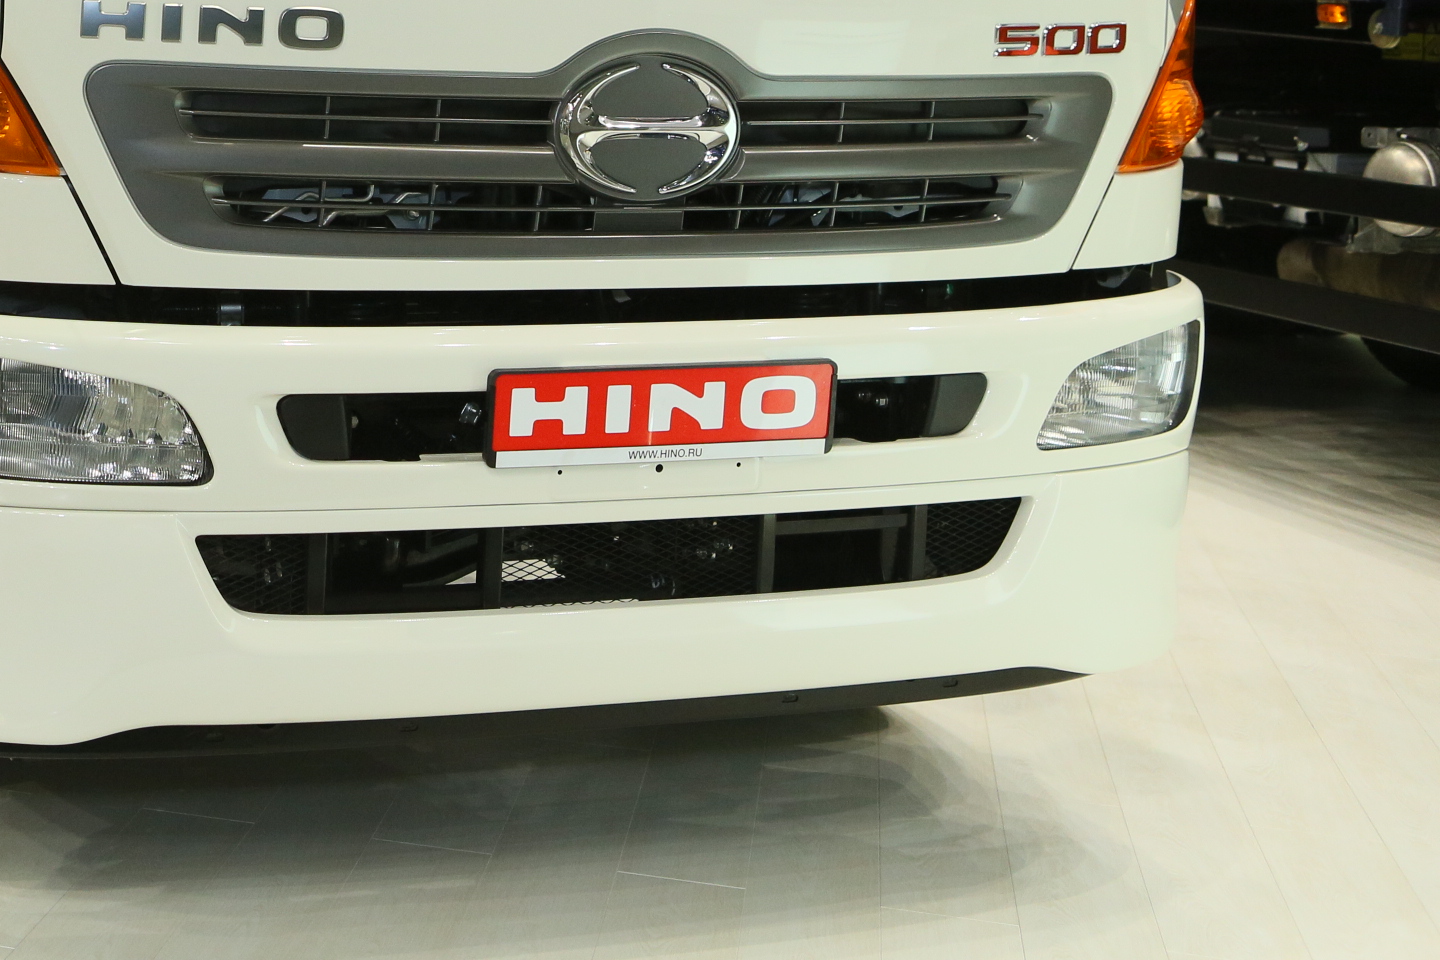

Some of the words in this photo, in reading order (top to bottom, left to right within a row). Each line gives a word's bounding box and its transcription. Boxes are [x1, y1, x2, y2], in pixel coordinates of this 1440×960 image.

[80, 0, 344, 50] HINO
[993, 21, 1127, 57] 500
[509, 375, 816, 437] HINO
[628, 448, 703, 460] WWW.HINO.RU
